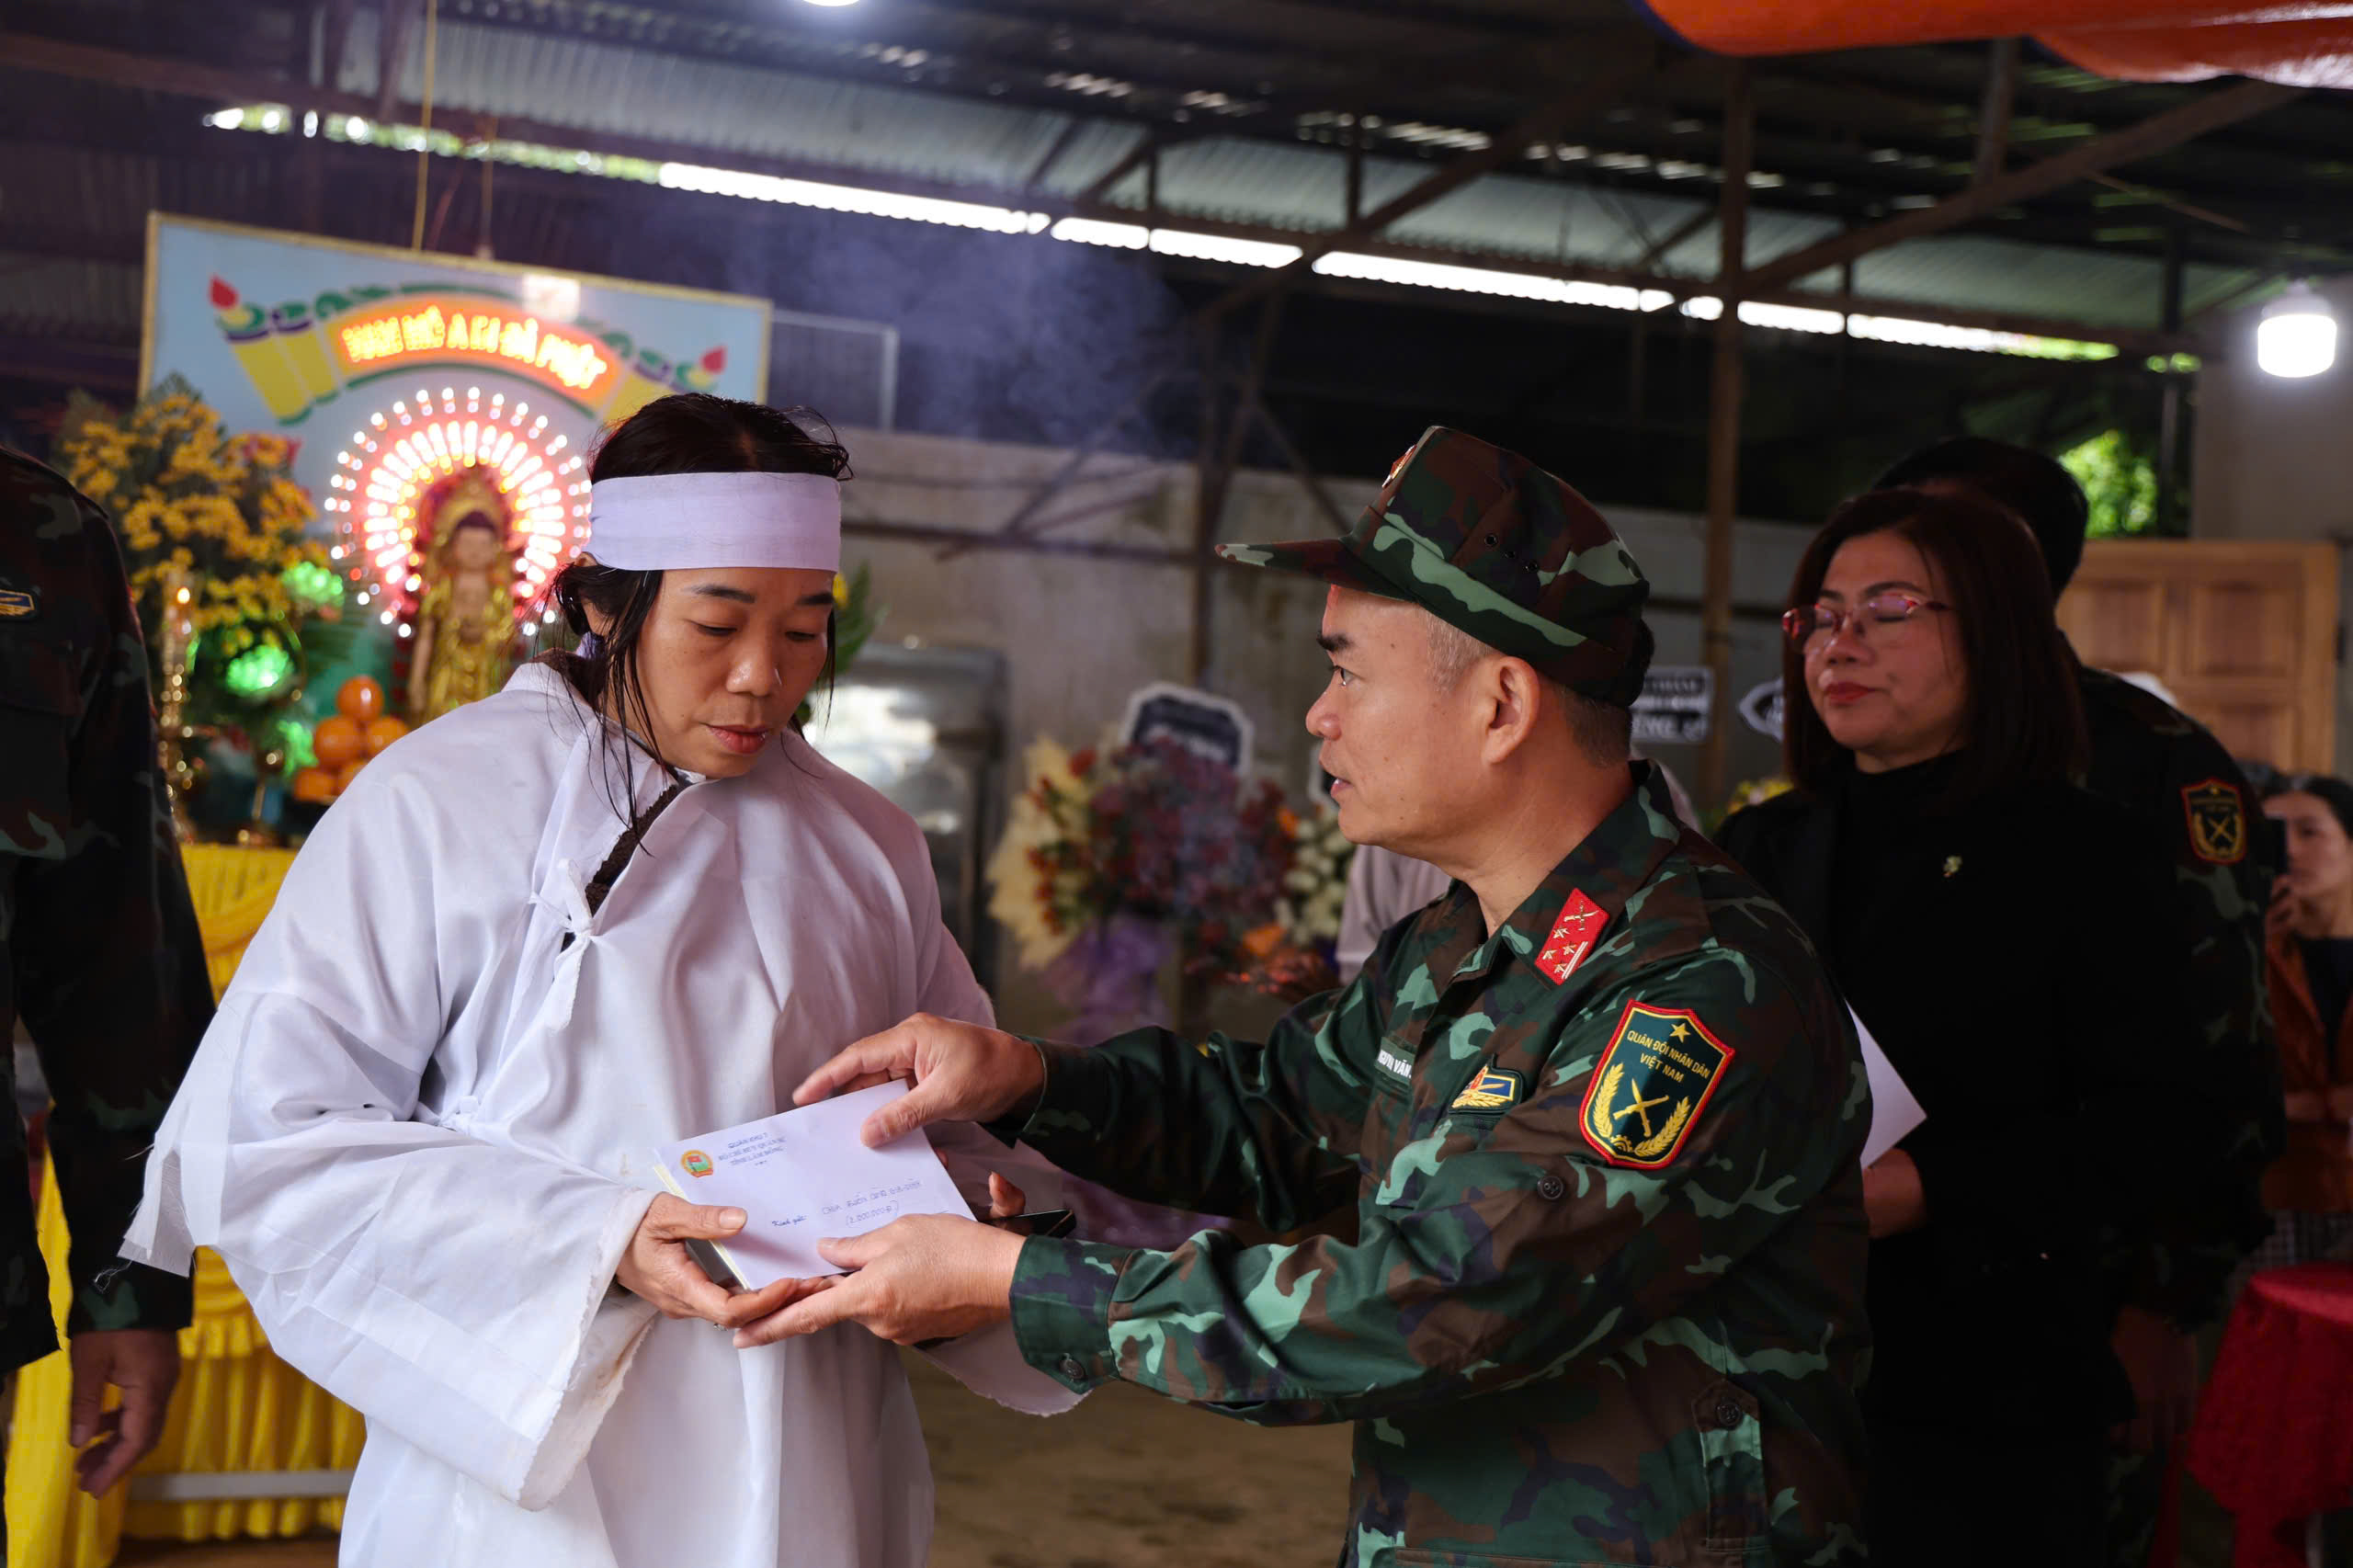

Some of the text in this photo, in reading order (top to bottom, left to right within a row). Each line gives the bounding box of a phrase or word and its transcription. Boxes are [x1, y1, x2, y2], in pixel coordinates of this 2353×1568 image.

[1627, 1029, 1711, 1079] QUÂN ĐỘI NHÂN DÂN
[1640, 1052, 1684, 1083] VIỆT NAM
